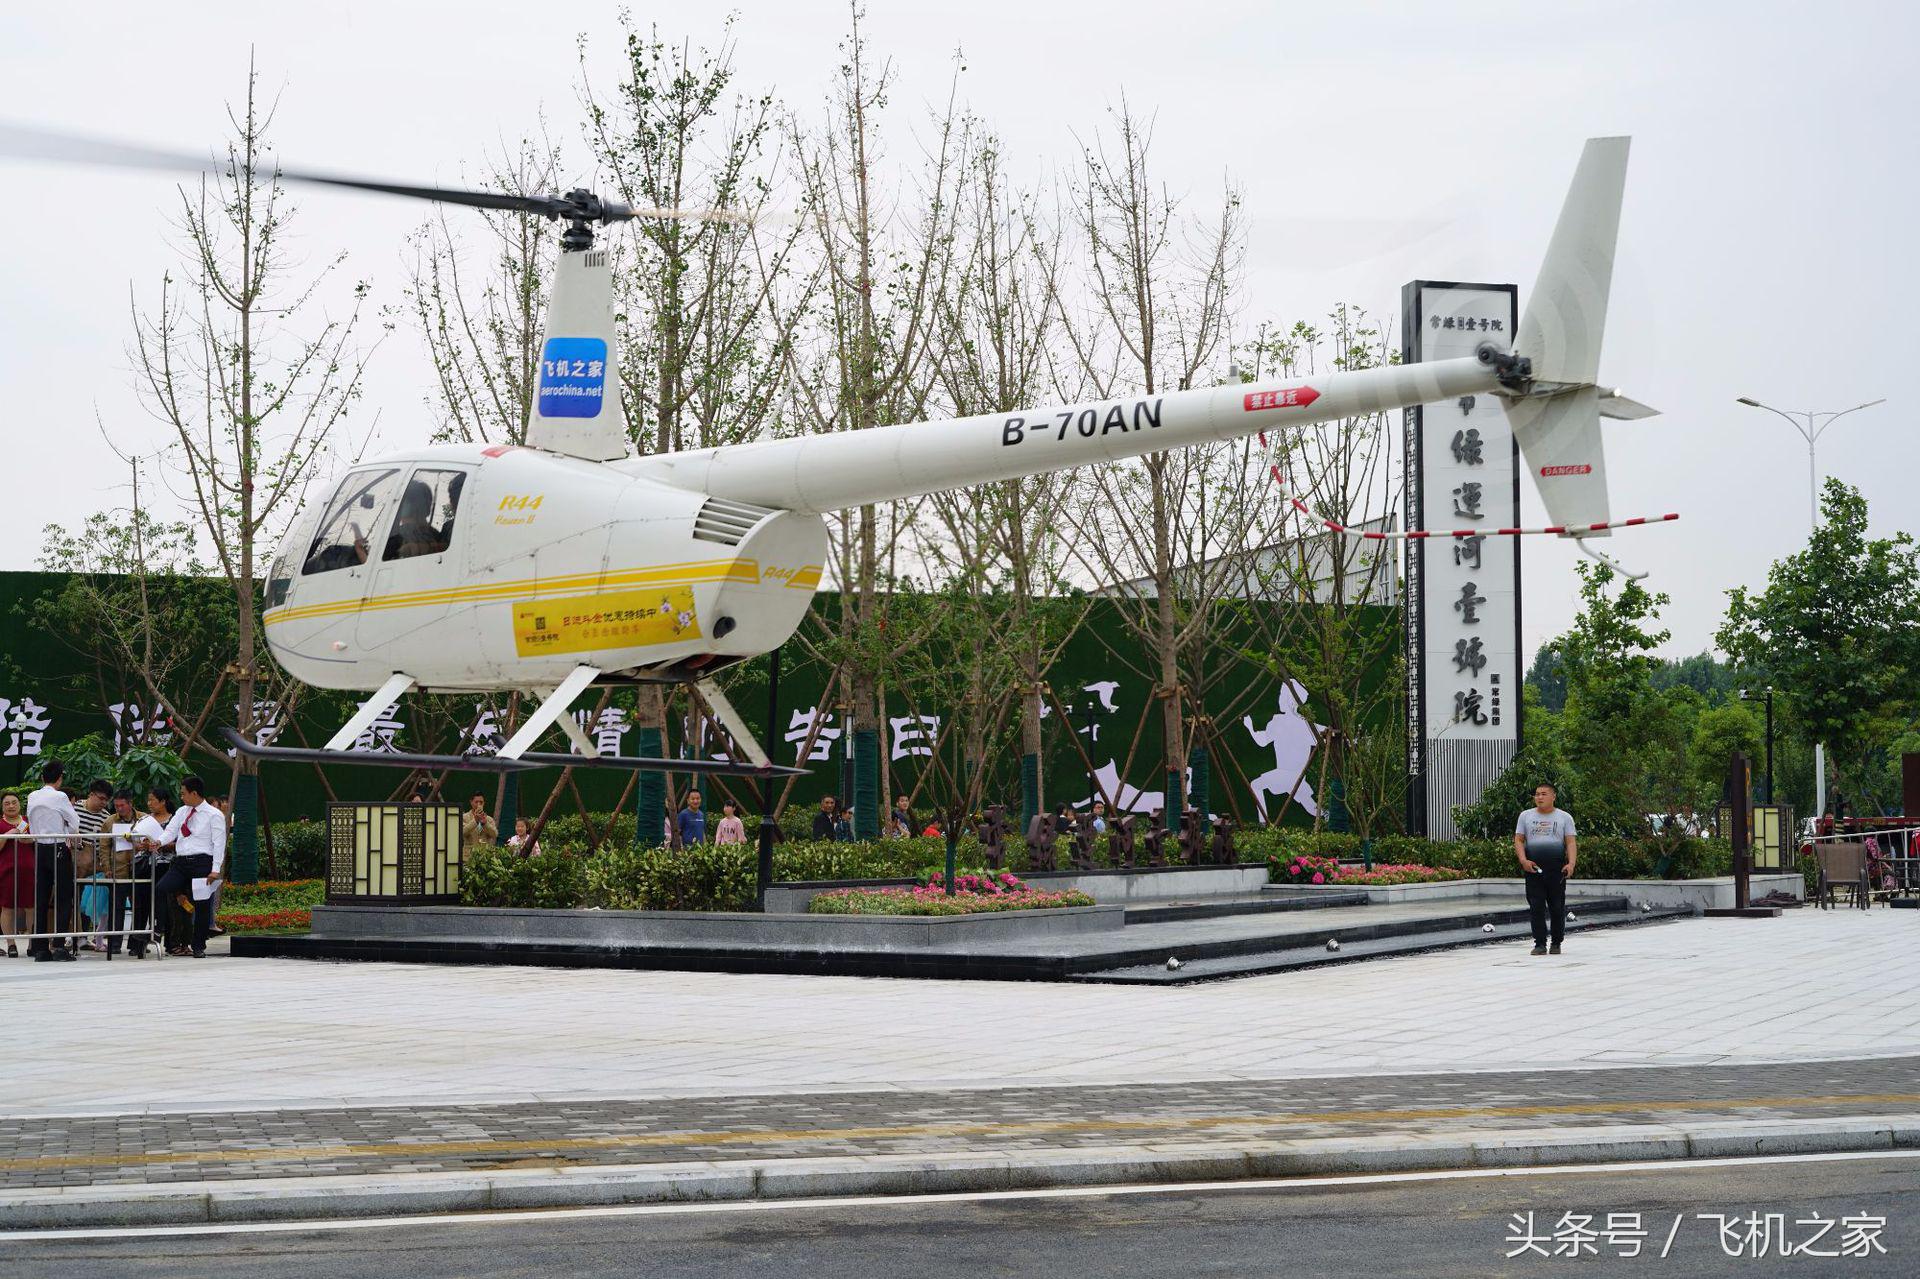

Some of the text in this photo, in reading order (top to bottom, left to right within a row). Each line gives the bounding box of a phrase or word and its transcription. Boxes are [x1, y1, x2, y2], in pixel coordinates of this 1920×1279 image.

[544, 359, 604, 378] 飞机之家
[540, 383, 603, 397] aerochina.net
[1002, 399, 1163, 446] B-70AN
[1545, 465, 1586, 476] DANGER
[498, 495, 545, 511] R44
